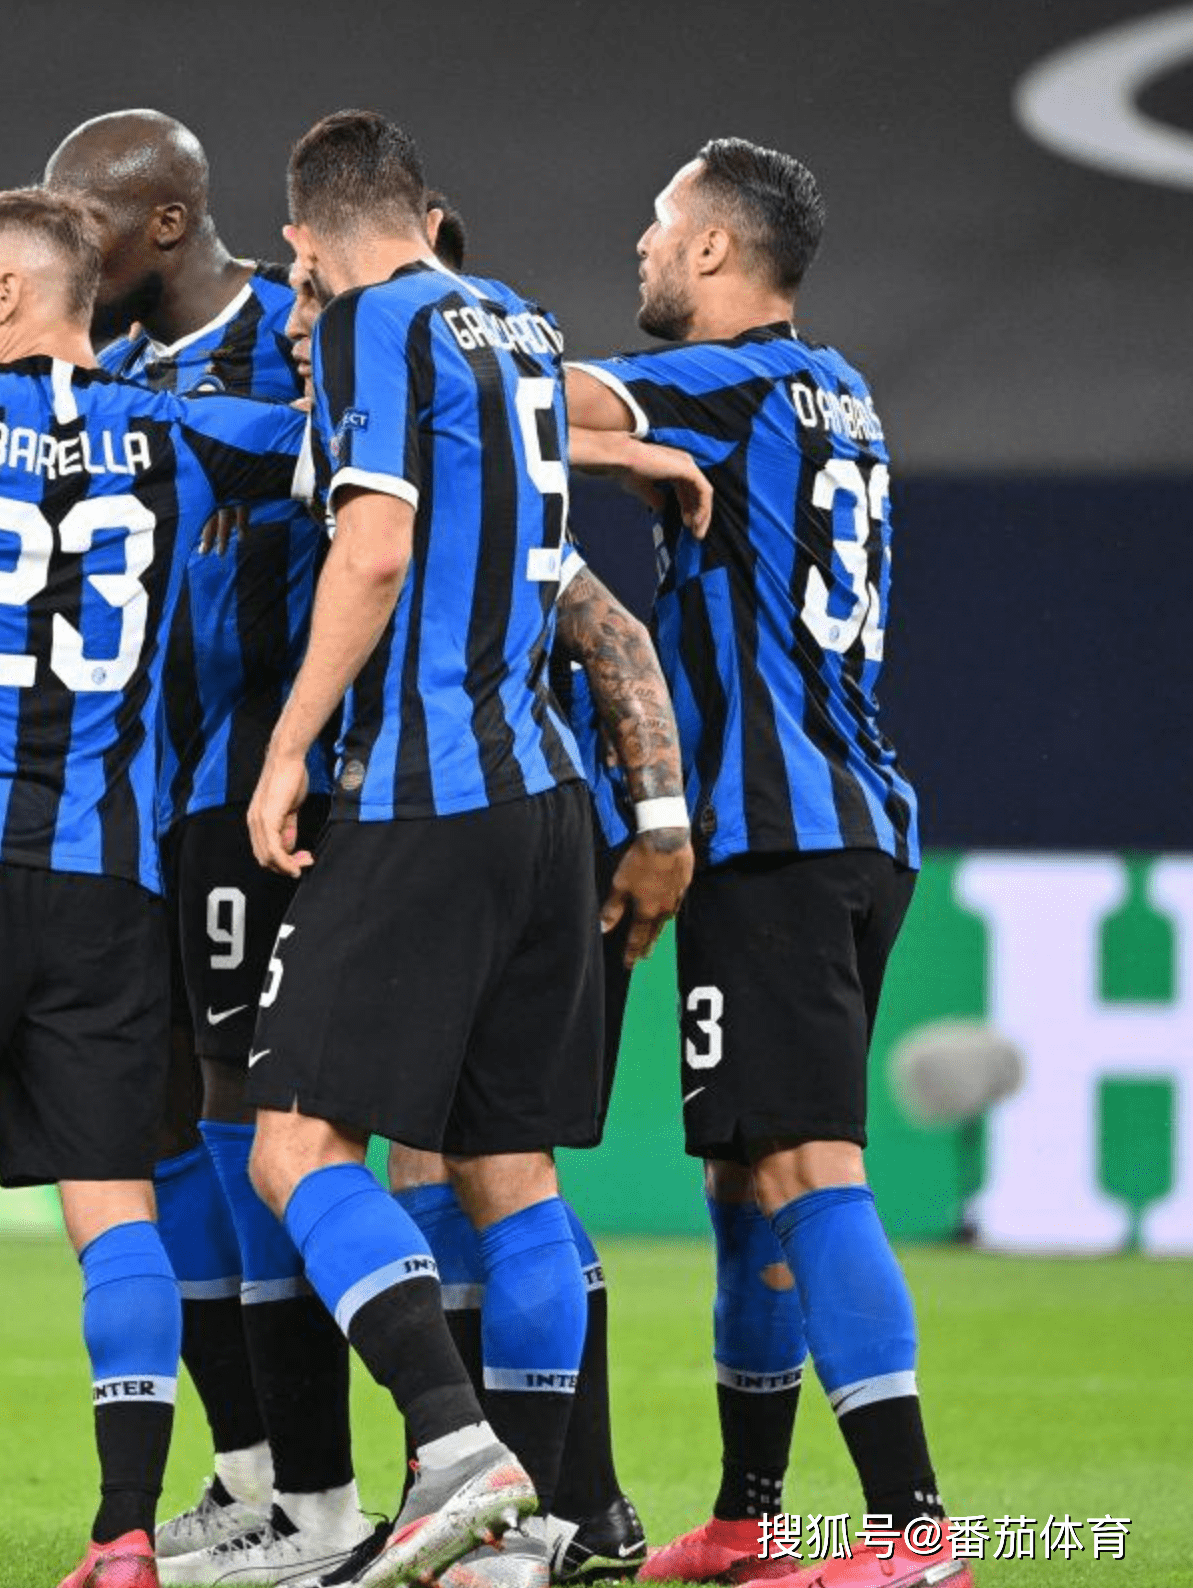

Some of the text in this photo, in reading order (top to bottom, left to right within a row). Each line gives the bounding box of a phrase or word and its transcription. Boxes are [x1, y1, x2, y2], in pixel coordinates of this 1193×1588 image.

[515, 377, 569, 582] 5
[206, 886, 246, 970] 9
[686, 986, 724, 1069] 3
